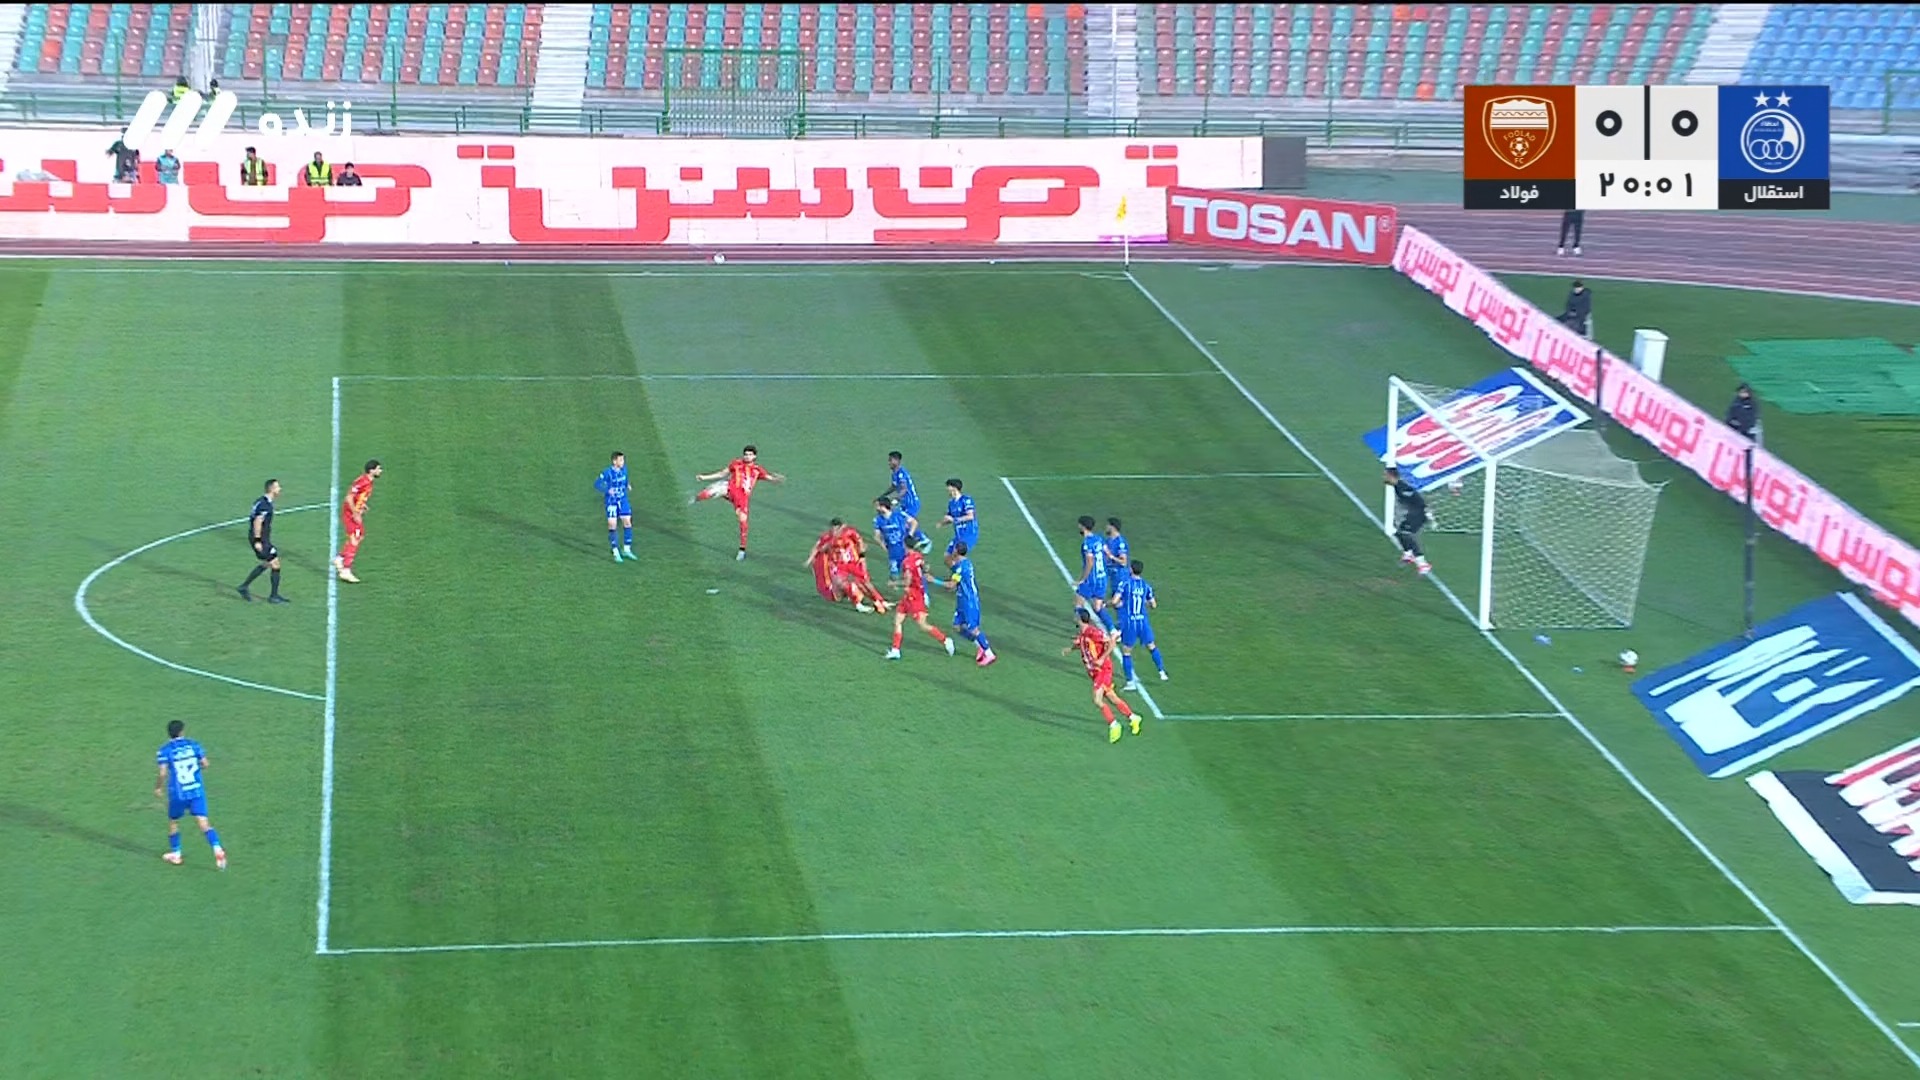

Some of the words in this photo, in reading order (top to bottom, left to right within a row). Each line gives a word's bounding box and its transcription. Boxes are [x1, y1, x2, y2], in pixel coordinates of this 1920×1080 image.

[1170, 195, 1378, 255] TOSAN
[1614, 380, 1706, 457] توسن
[1132, 595, 1143, 615] 11
